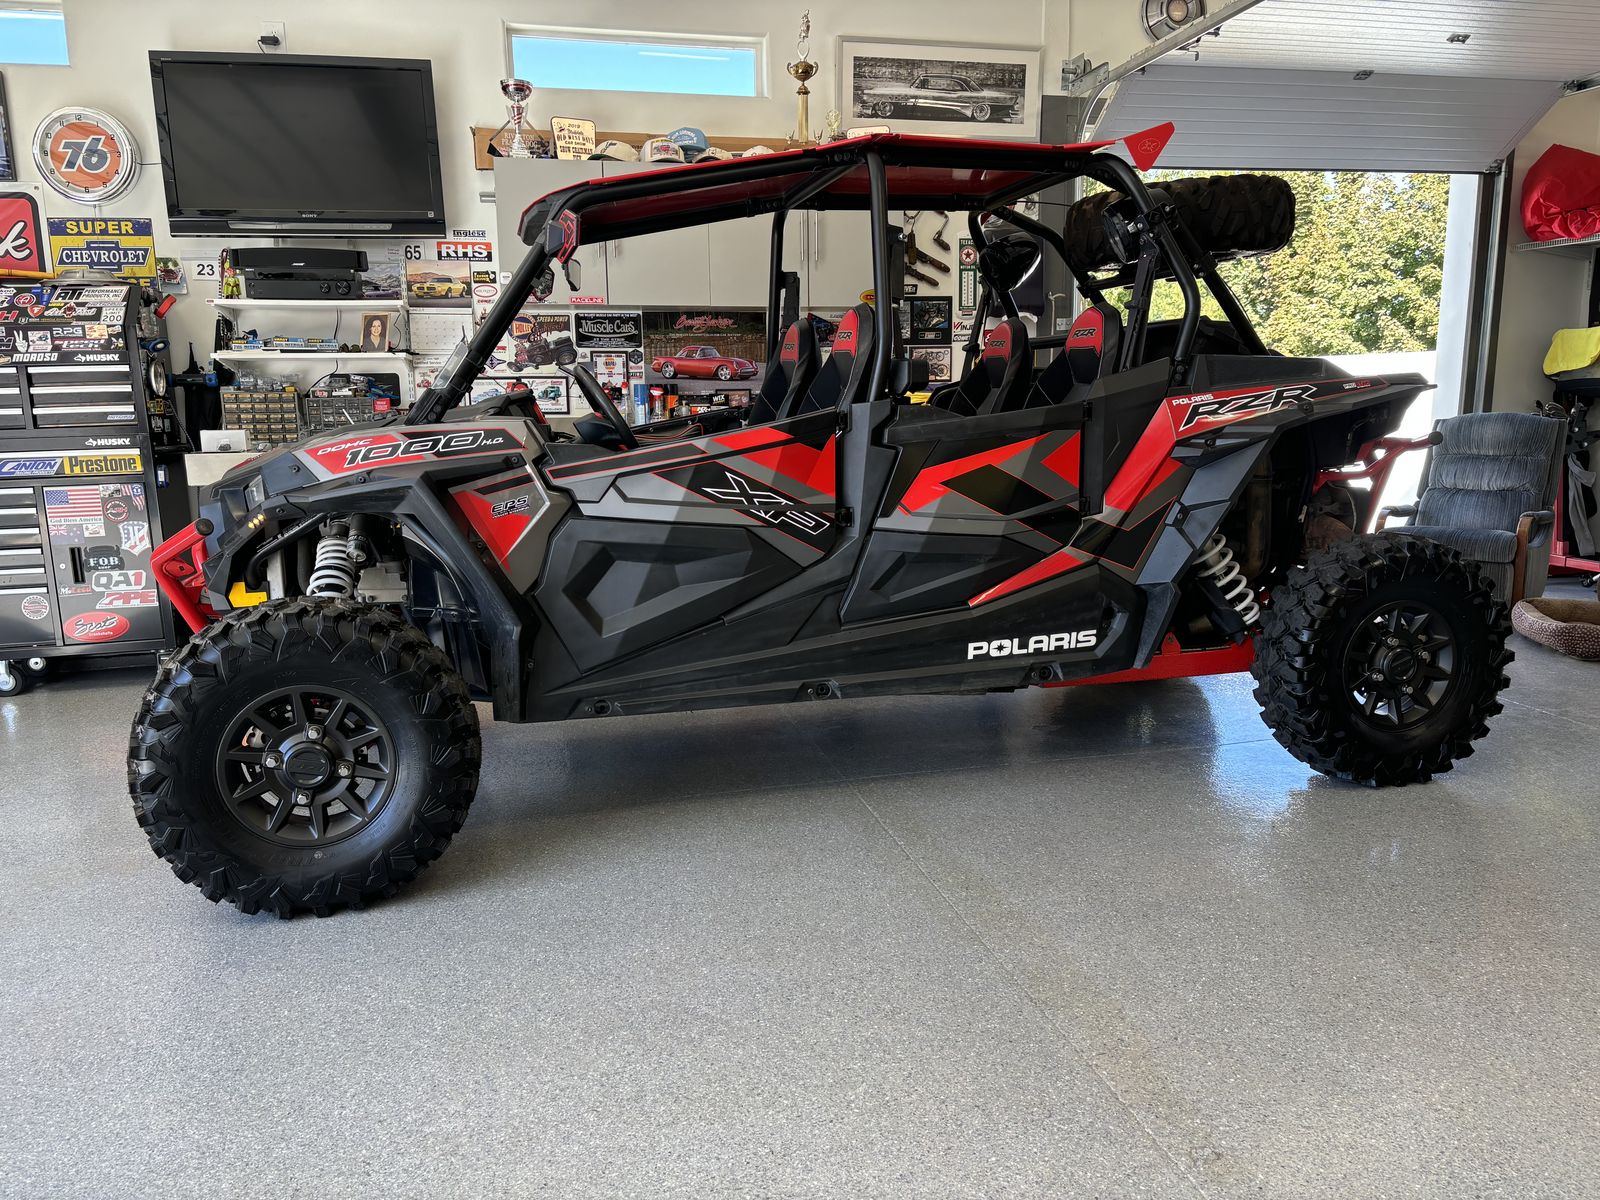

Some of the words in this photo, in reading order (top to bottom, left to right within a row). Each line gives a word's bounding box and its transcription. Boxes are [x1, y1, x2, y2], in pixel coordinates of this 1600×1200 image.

[58, 135, 111, 173] 76
[65, 221, 135, 235] SUPER
[453, 229, 487, 237] Inglese
[62, 249, 145, 264] CHEVROLET
[404, 245, 422, 260] 65
[441, 244, 488, 257] RHS
[196, 263, 215, 276] 23
[102, 314, 122, 322] 200
[53, 327, 83, 335] RPG
[581, 319, 614, 333] Muscle
[614, 320, 635, 333] Cars
[1072, 327, 1097, 339] RZR
[838, 331, 853, 340] RZR
[12, 353, 58, 362] MOROSO
[1172, 393, 1214, 406] POLARIS
[1178, 384, 1318, 431] RZR
[97, 438, 130, 446] HUSKY
[316, 438, 373, 455] DOHC
[482, 437, 504, 446] H.O.
[344, 431, 485, 468] 1000
[0, 458, 58, 476] CANTON
[68, 455, 138, 472] Prestone
[491, 495, 529, 514] EPS
[701, 471, 830, 535] XP
[78, 516, 102, 524] America
[93, 571, 145, 591] QA1
[98, 590, 158, 606] PPE
[967, 629, 1097, 660] POLARIS
